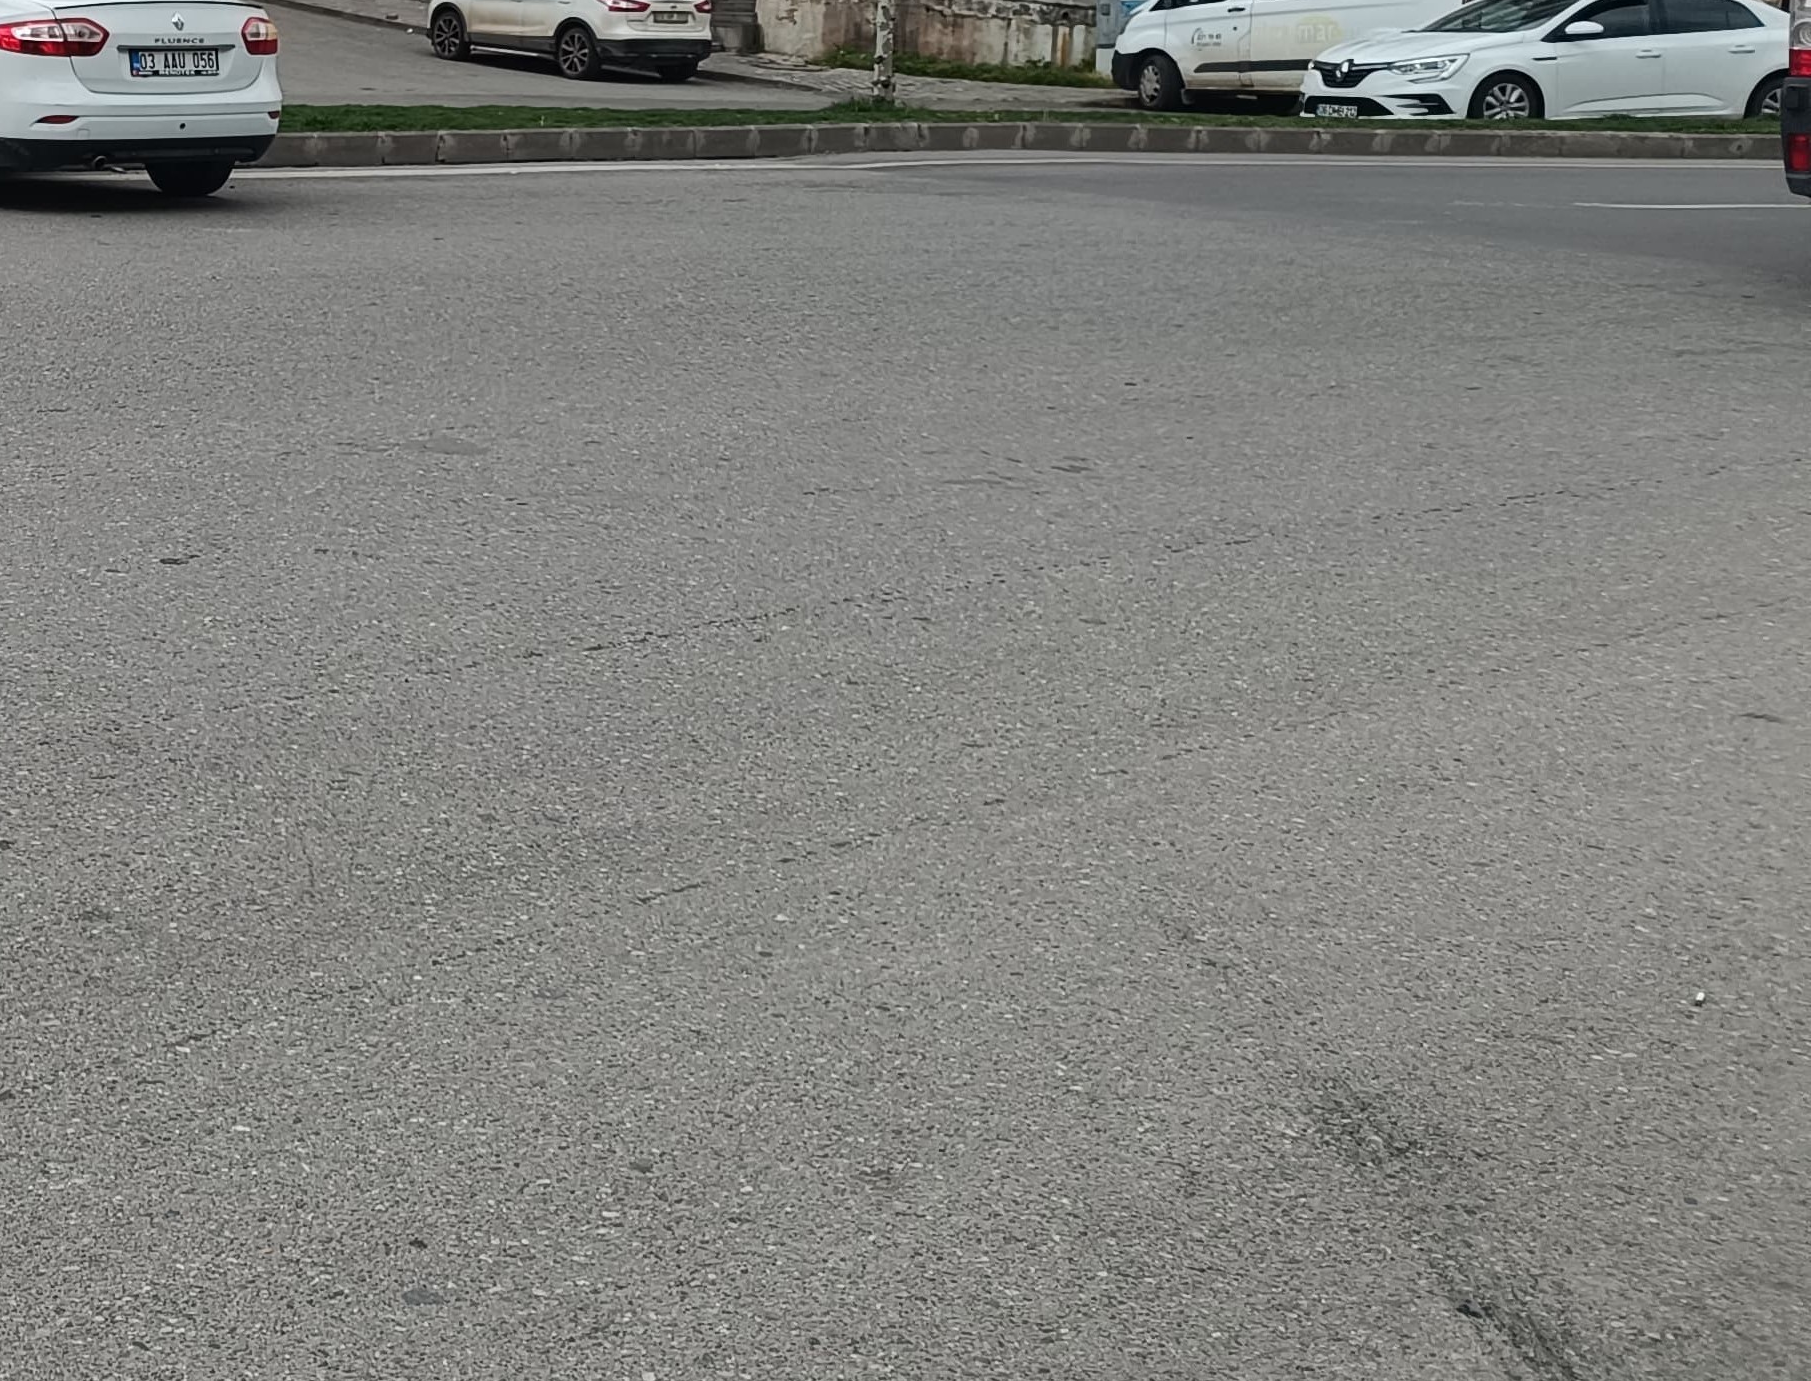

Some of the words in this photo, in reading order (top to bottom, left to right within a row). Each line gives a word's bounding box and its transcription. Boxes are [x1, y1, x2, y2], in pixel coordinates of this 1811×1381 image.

[139, 53, 156, 69] 03
[163, 52, 186, 69] AAU
[193, 52, 215, 69] 056
